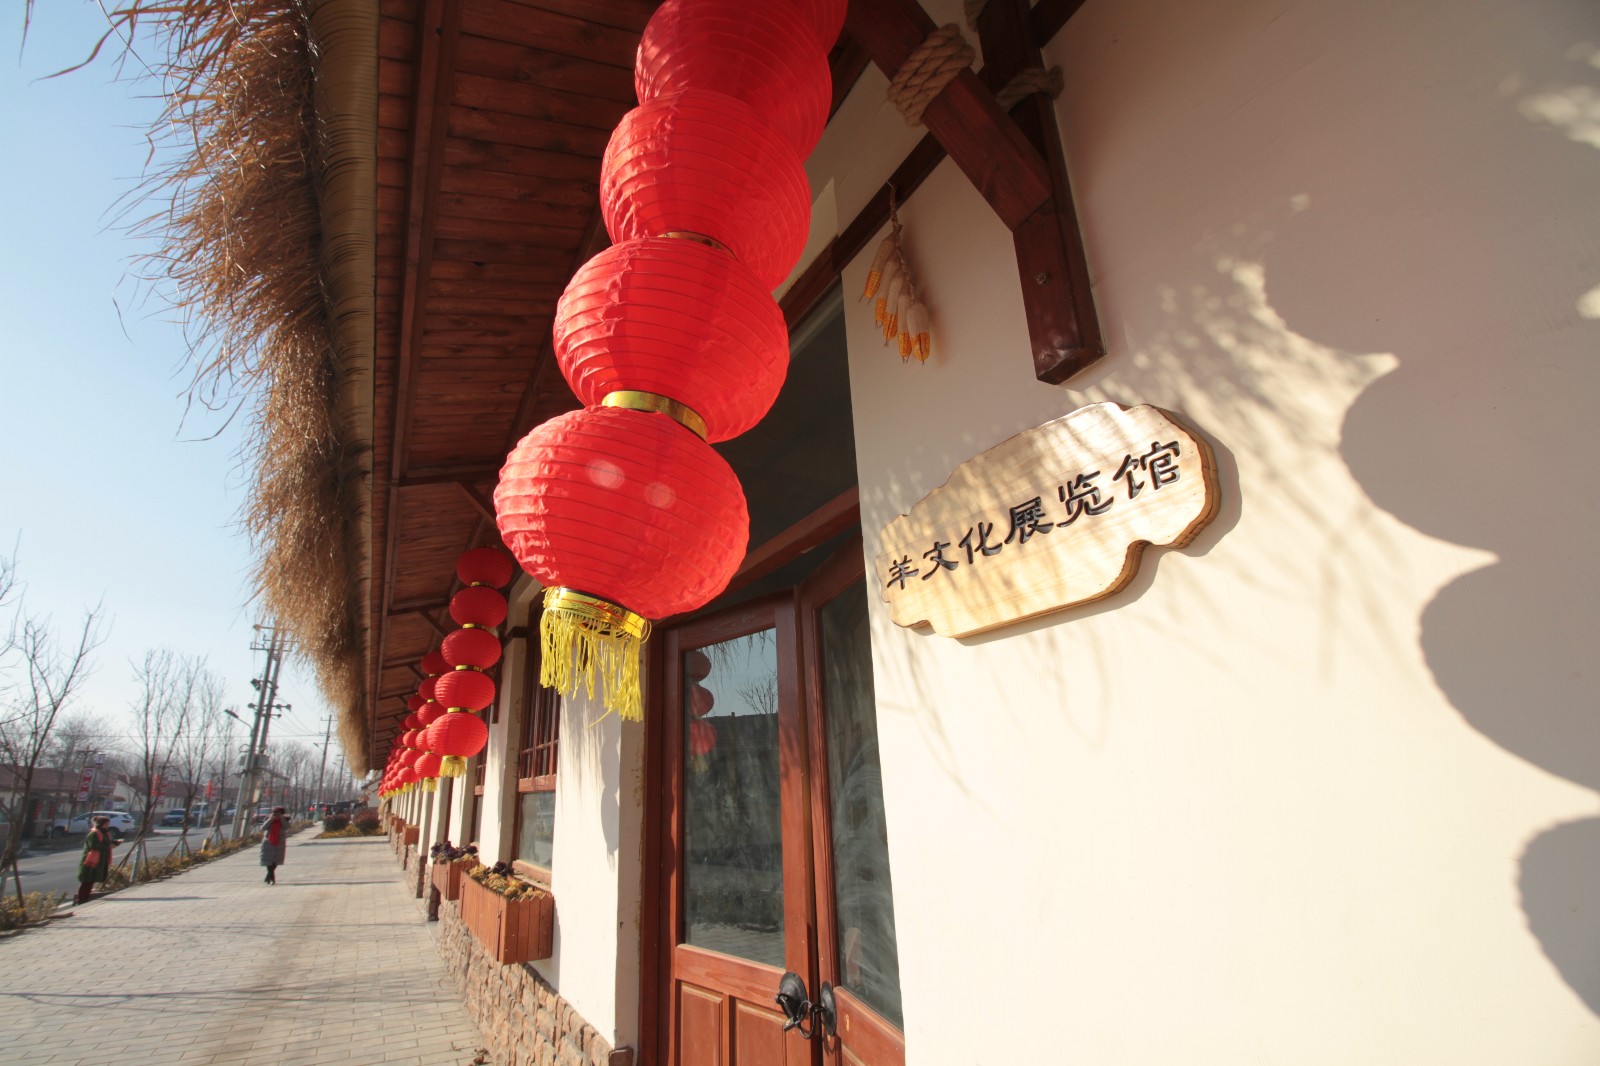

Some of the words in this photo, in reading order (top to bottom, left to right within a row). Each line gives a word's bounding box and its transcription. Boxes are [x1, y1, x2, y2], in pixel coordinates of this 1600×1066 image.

[887, 441, 1181, 590] 羊文化展览馆
